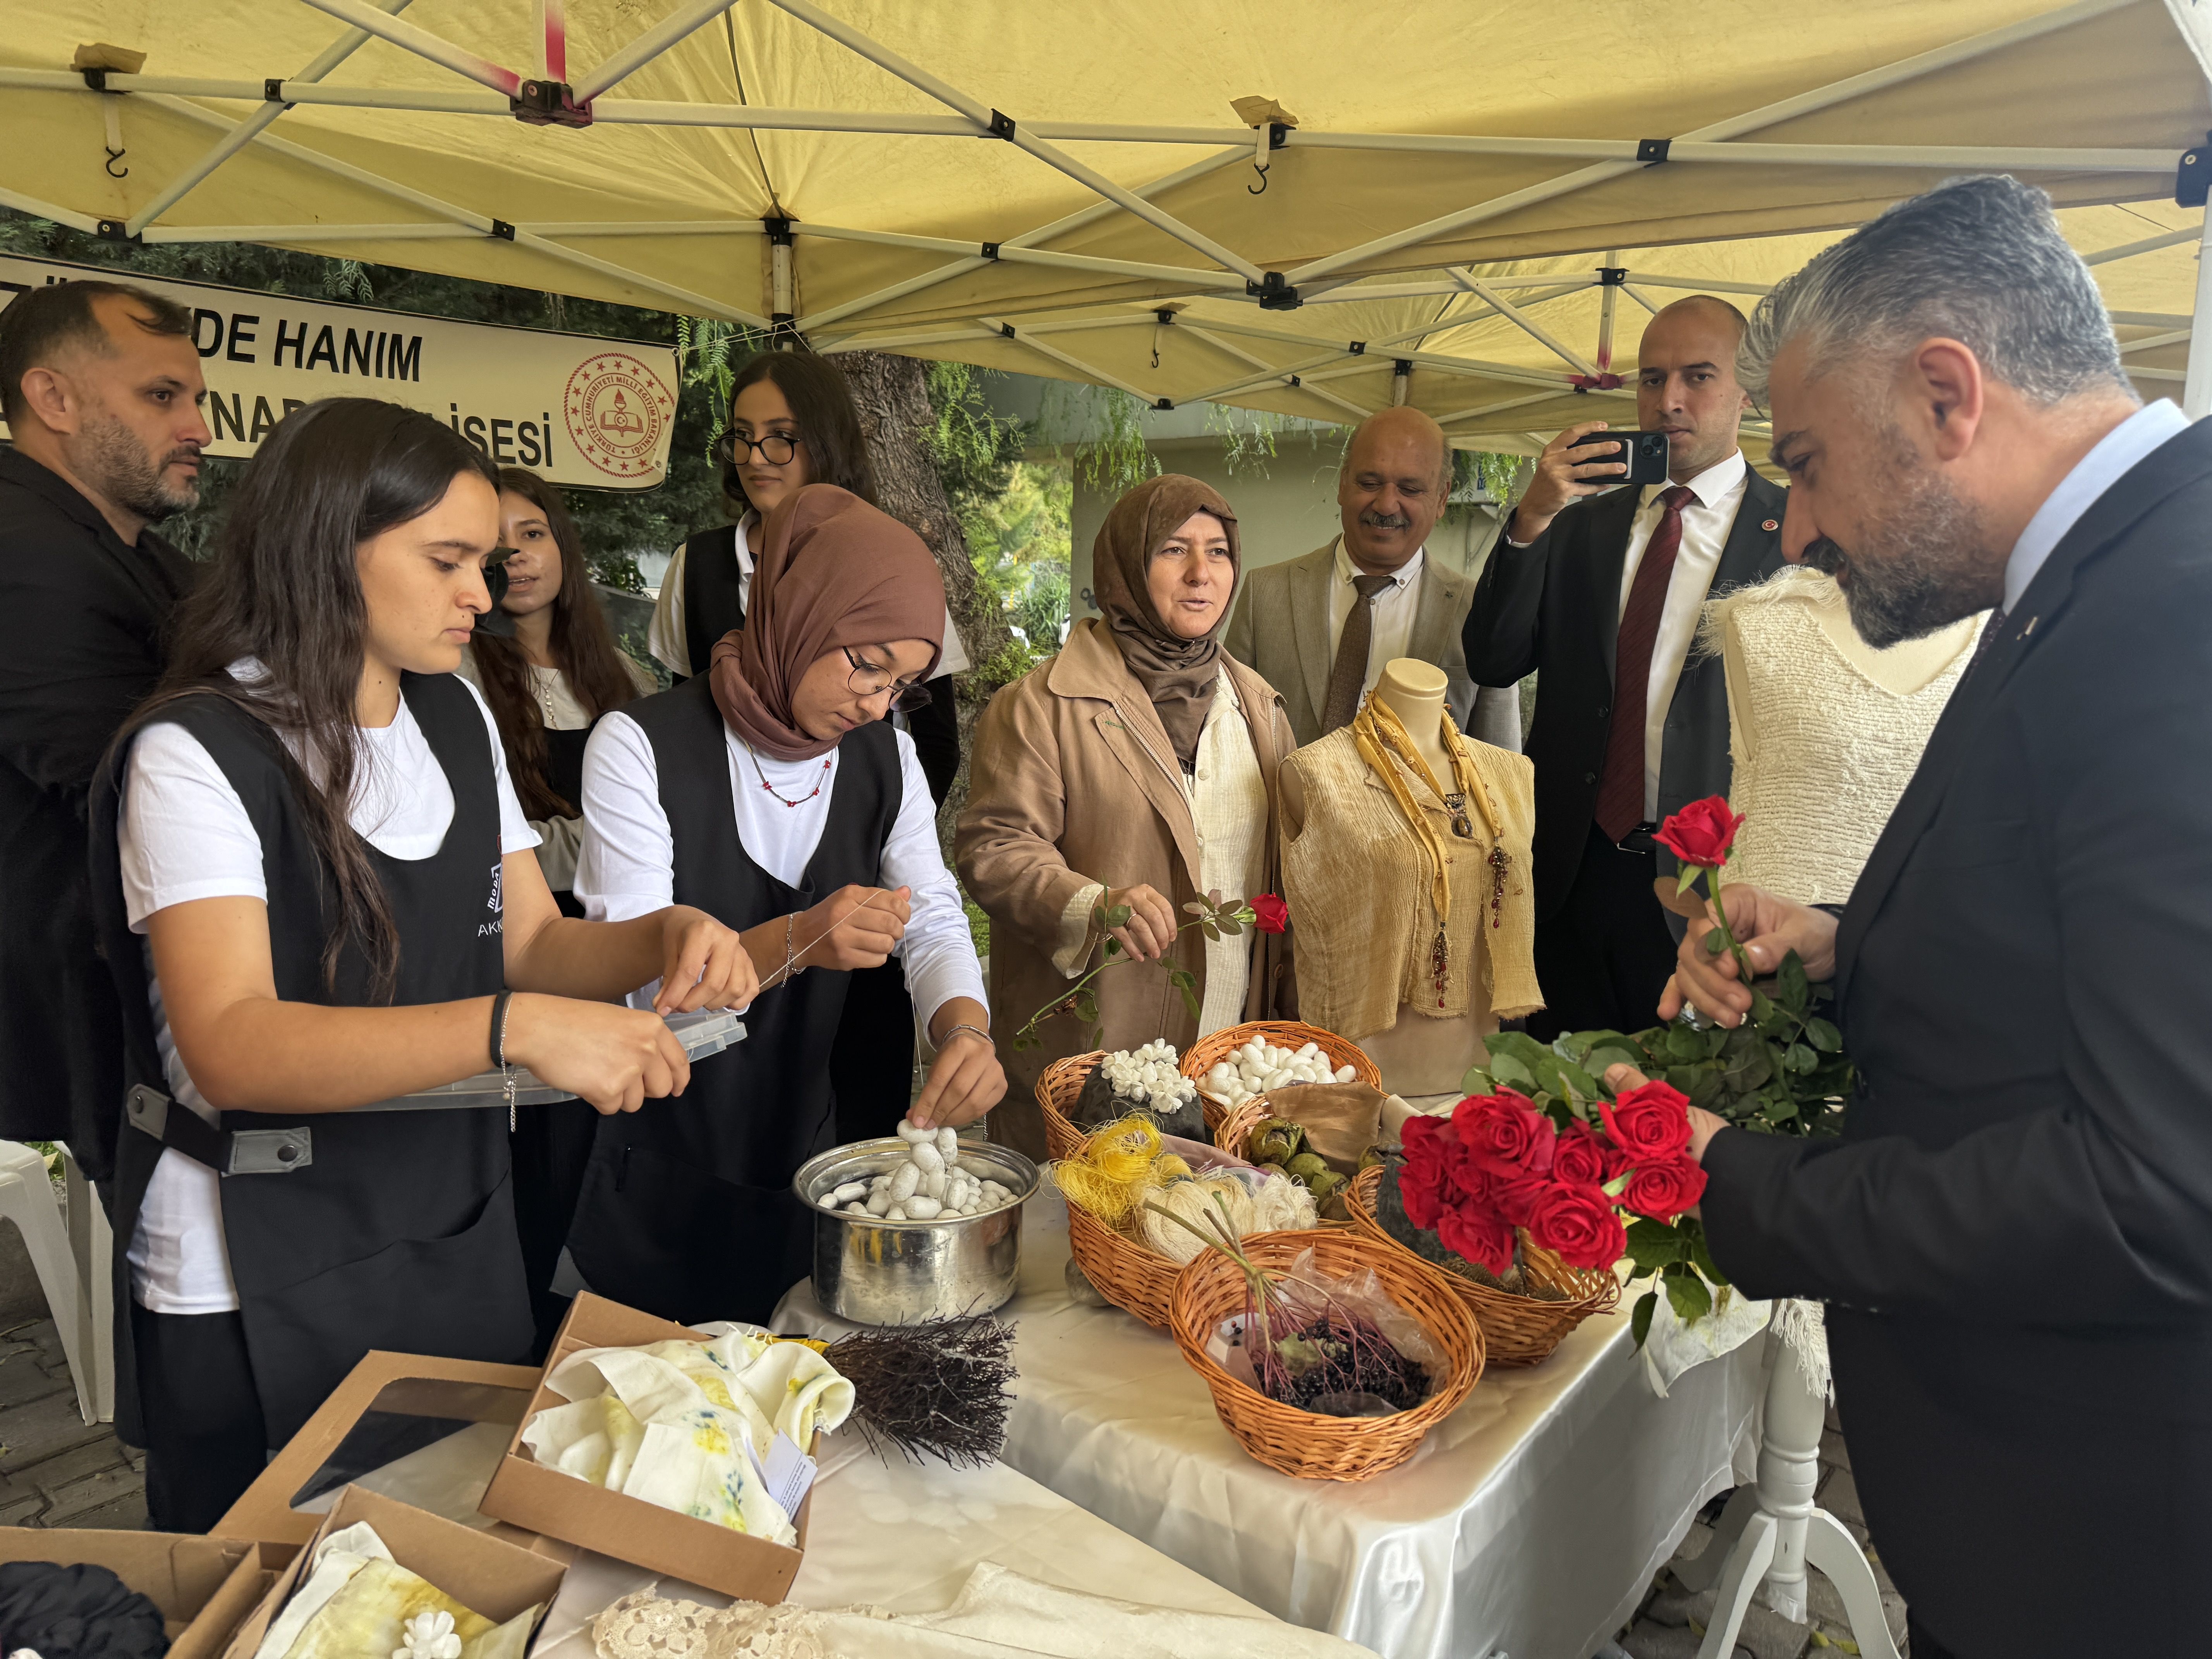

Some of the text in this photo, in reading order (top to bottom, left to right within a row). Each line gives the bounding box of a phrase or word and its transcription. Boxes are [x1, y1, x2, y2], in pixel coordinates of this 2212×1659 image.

[274, 319, 422, 382] HANIM
[585, 375, 614, 422] CUMHURİYETİ
[638, 388, 657, 416] EĞİTİM
[450, 402, 553, 467] İSESİ
[588, 424, 616, 453] TÜRKİYE
[631, 419, 658, 455] BAKANLIĞI
[478, 919, 503, 937] AKK
